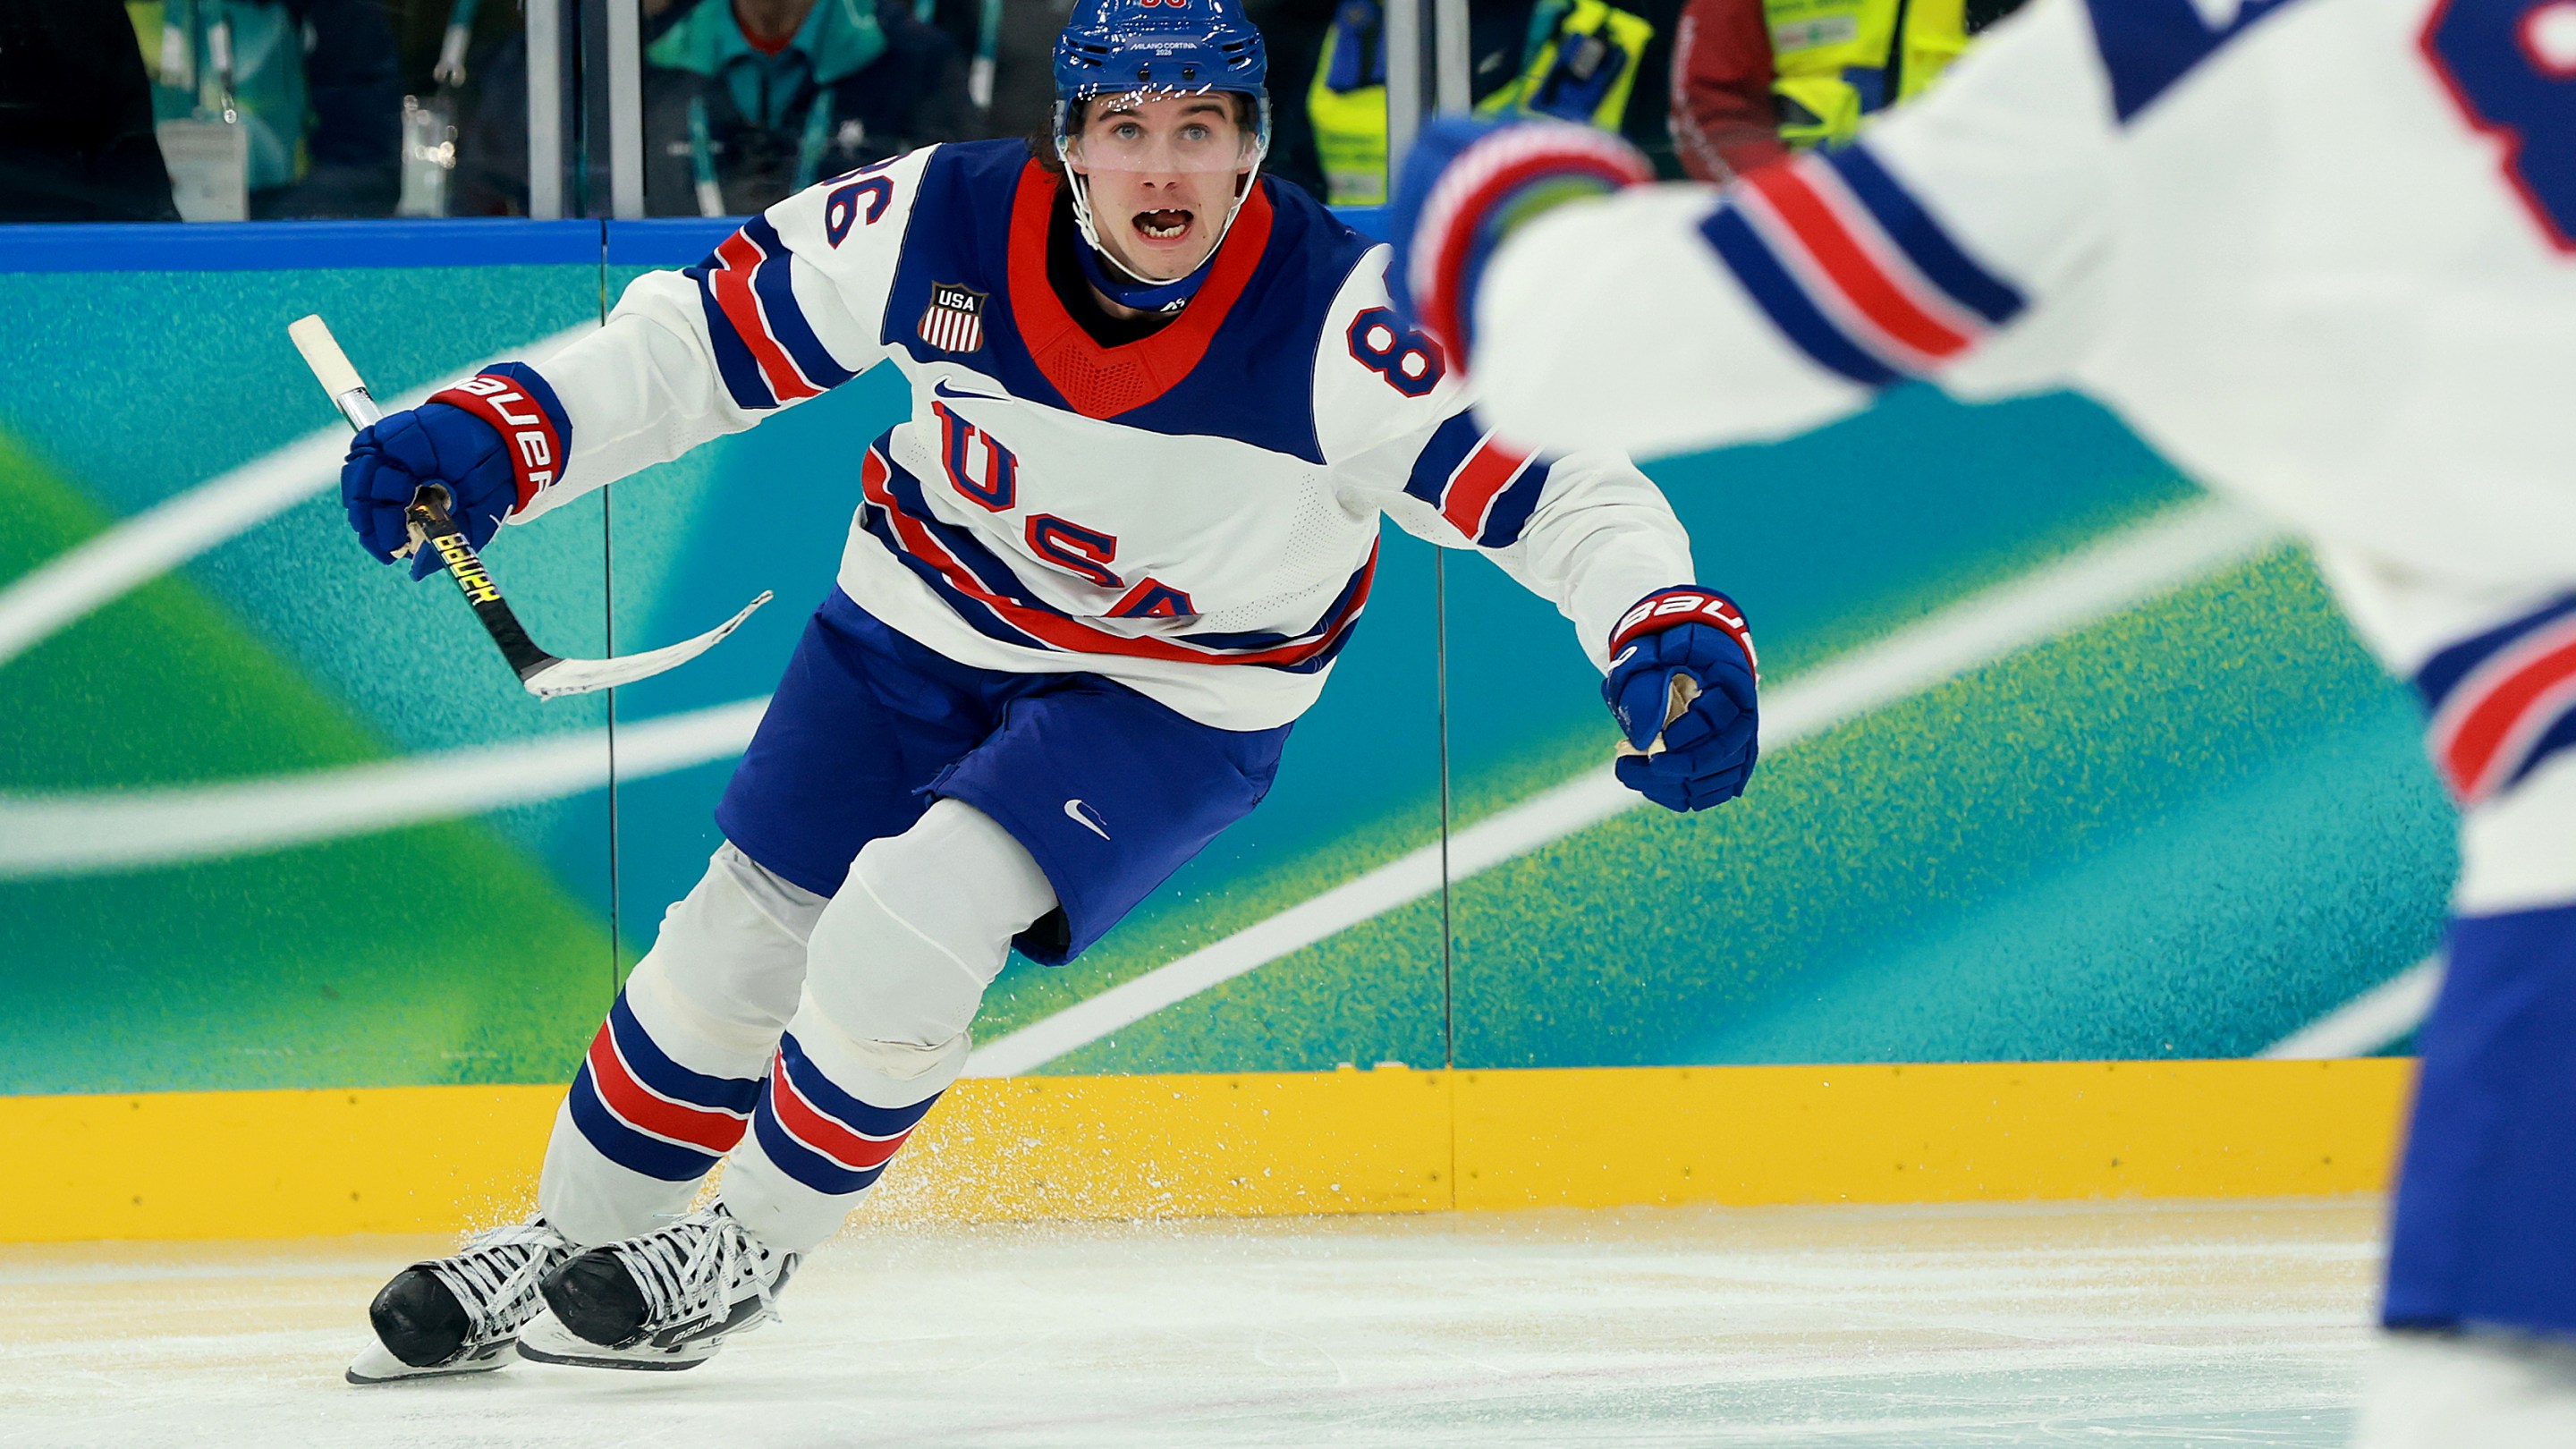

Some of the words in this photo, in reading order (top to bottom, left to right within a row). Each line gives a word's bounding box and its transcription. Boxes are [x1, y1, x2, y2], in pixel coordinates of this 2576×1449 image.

[1130, 42, 1163, 50] MILANO
[938, 289, 975, 311] USA
[431, 532, 502, 606] BAUER
